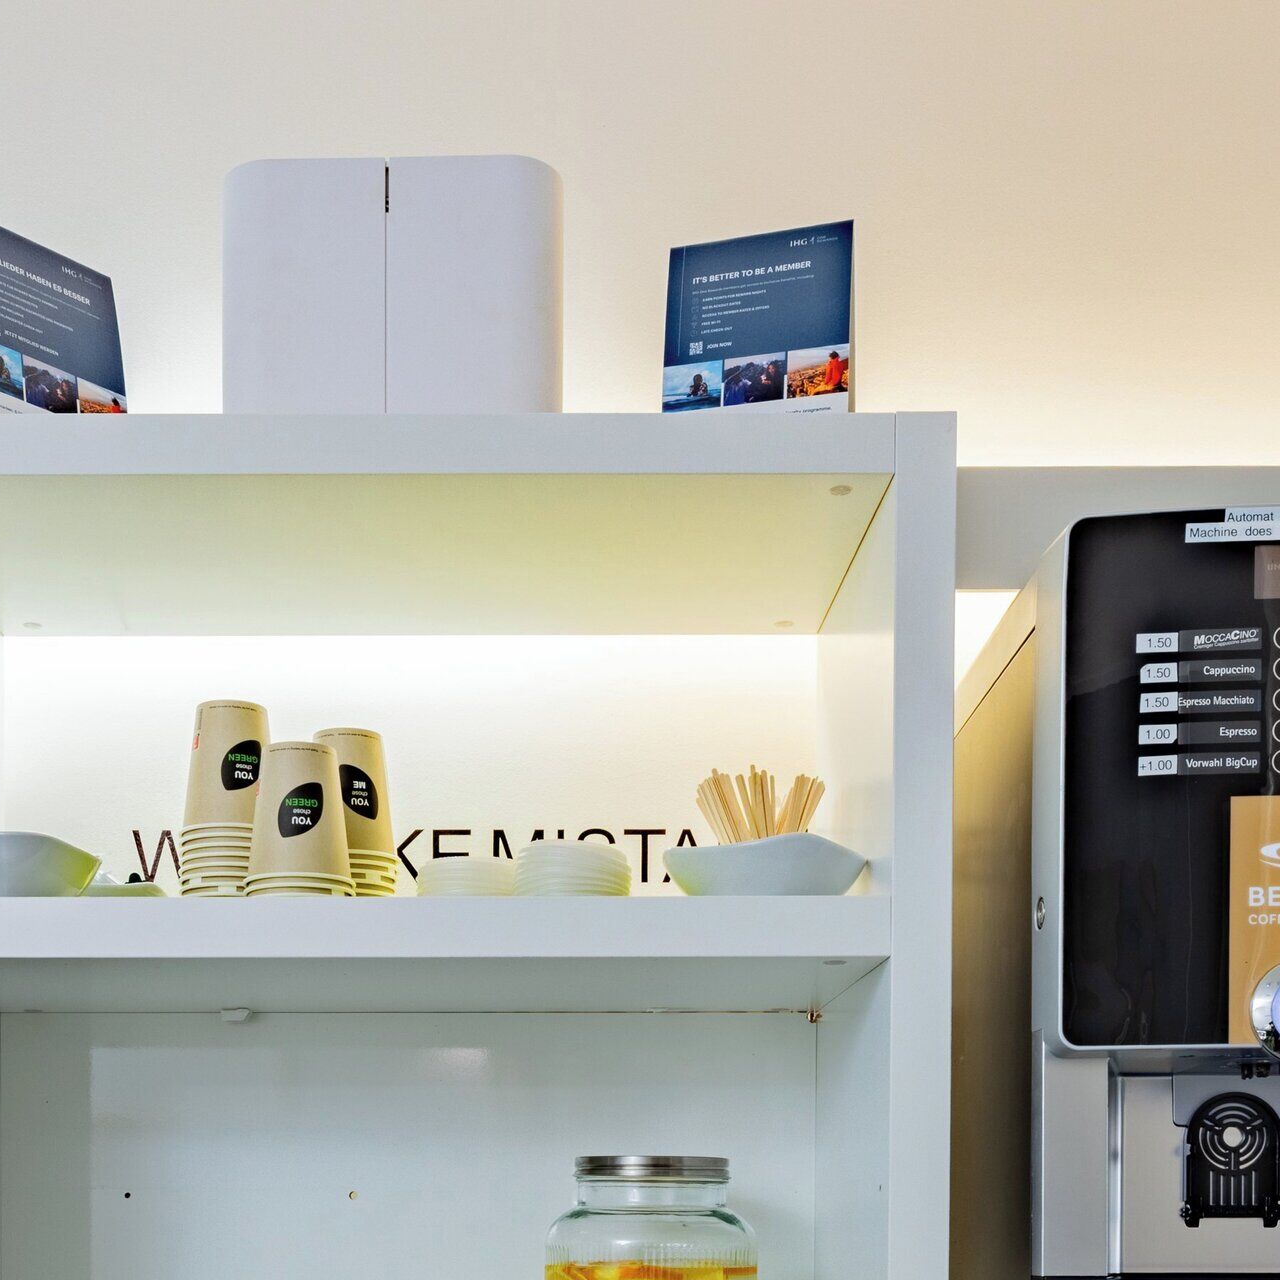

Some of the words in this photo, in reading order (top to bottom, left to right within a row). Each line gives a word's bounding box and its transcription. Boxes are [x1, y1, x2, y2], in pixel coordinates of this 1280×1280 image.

[790, 238, 808, 247] IHG
[692, 276, 708, 285] IT'S
[709, 271, 739, 282] BETTER
[755, 267, 765, 275] BE
[775, 260, 812, 273] MEMBER
[26, 271, 51, 288] HABEN
[53, 283, 62, 293] ES
[63, 288, 91, 306] BESSER
[1227, 511, 1274, 523] Automat
[1189, 527, 1238, 538] Machine
[1245, 526, 1272, 537] does
[1147, 637, 1172, 648] 1.50
[1146, 668, 1171, 678] 1.50
[1203, 666, 1255, 676] Cappuccino
[1145, 697, 1169, 707] 1.50
[1178, 697, 1211, 707] Espresso
[1213, 696, 1254, 705] Macchiato
[1145, 729, 1171, 740] 1.00
[1220, 726, 1257, 738] Espresso
[228, 753, 259, 763] GREEN
[1186, 758, 1223, 768] Vorwahl
[1225, 757, 1258, 768] BigCup
[1139, 760, 1172, 771] +1.00
[234, 770, 254, 781] YOU
[352, 780, 366, 789] ME
[285, 798, 318, 807] GREEN
[351, 797, 369, 807] YOU
[291, 816, 312, 826] YOU
[396, 829, 472, 883] KE
